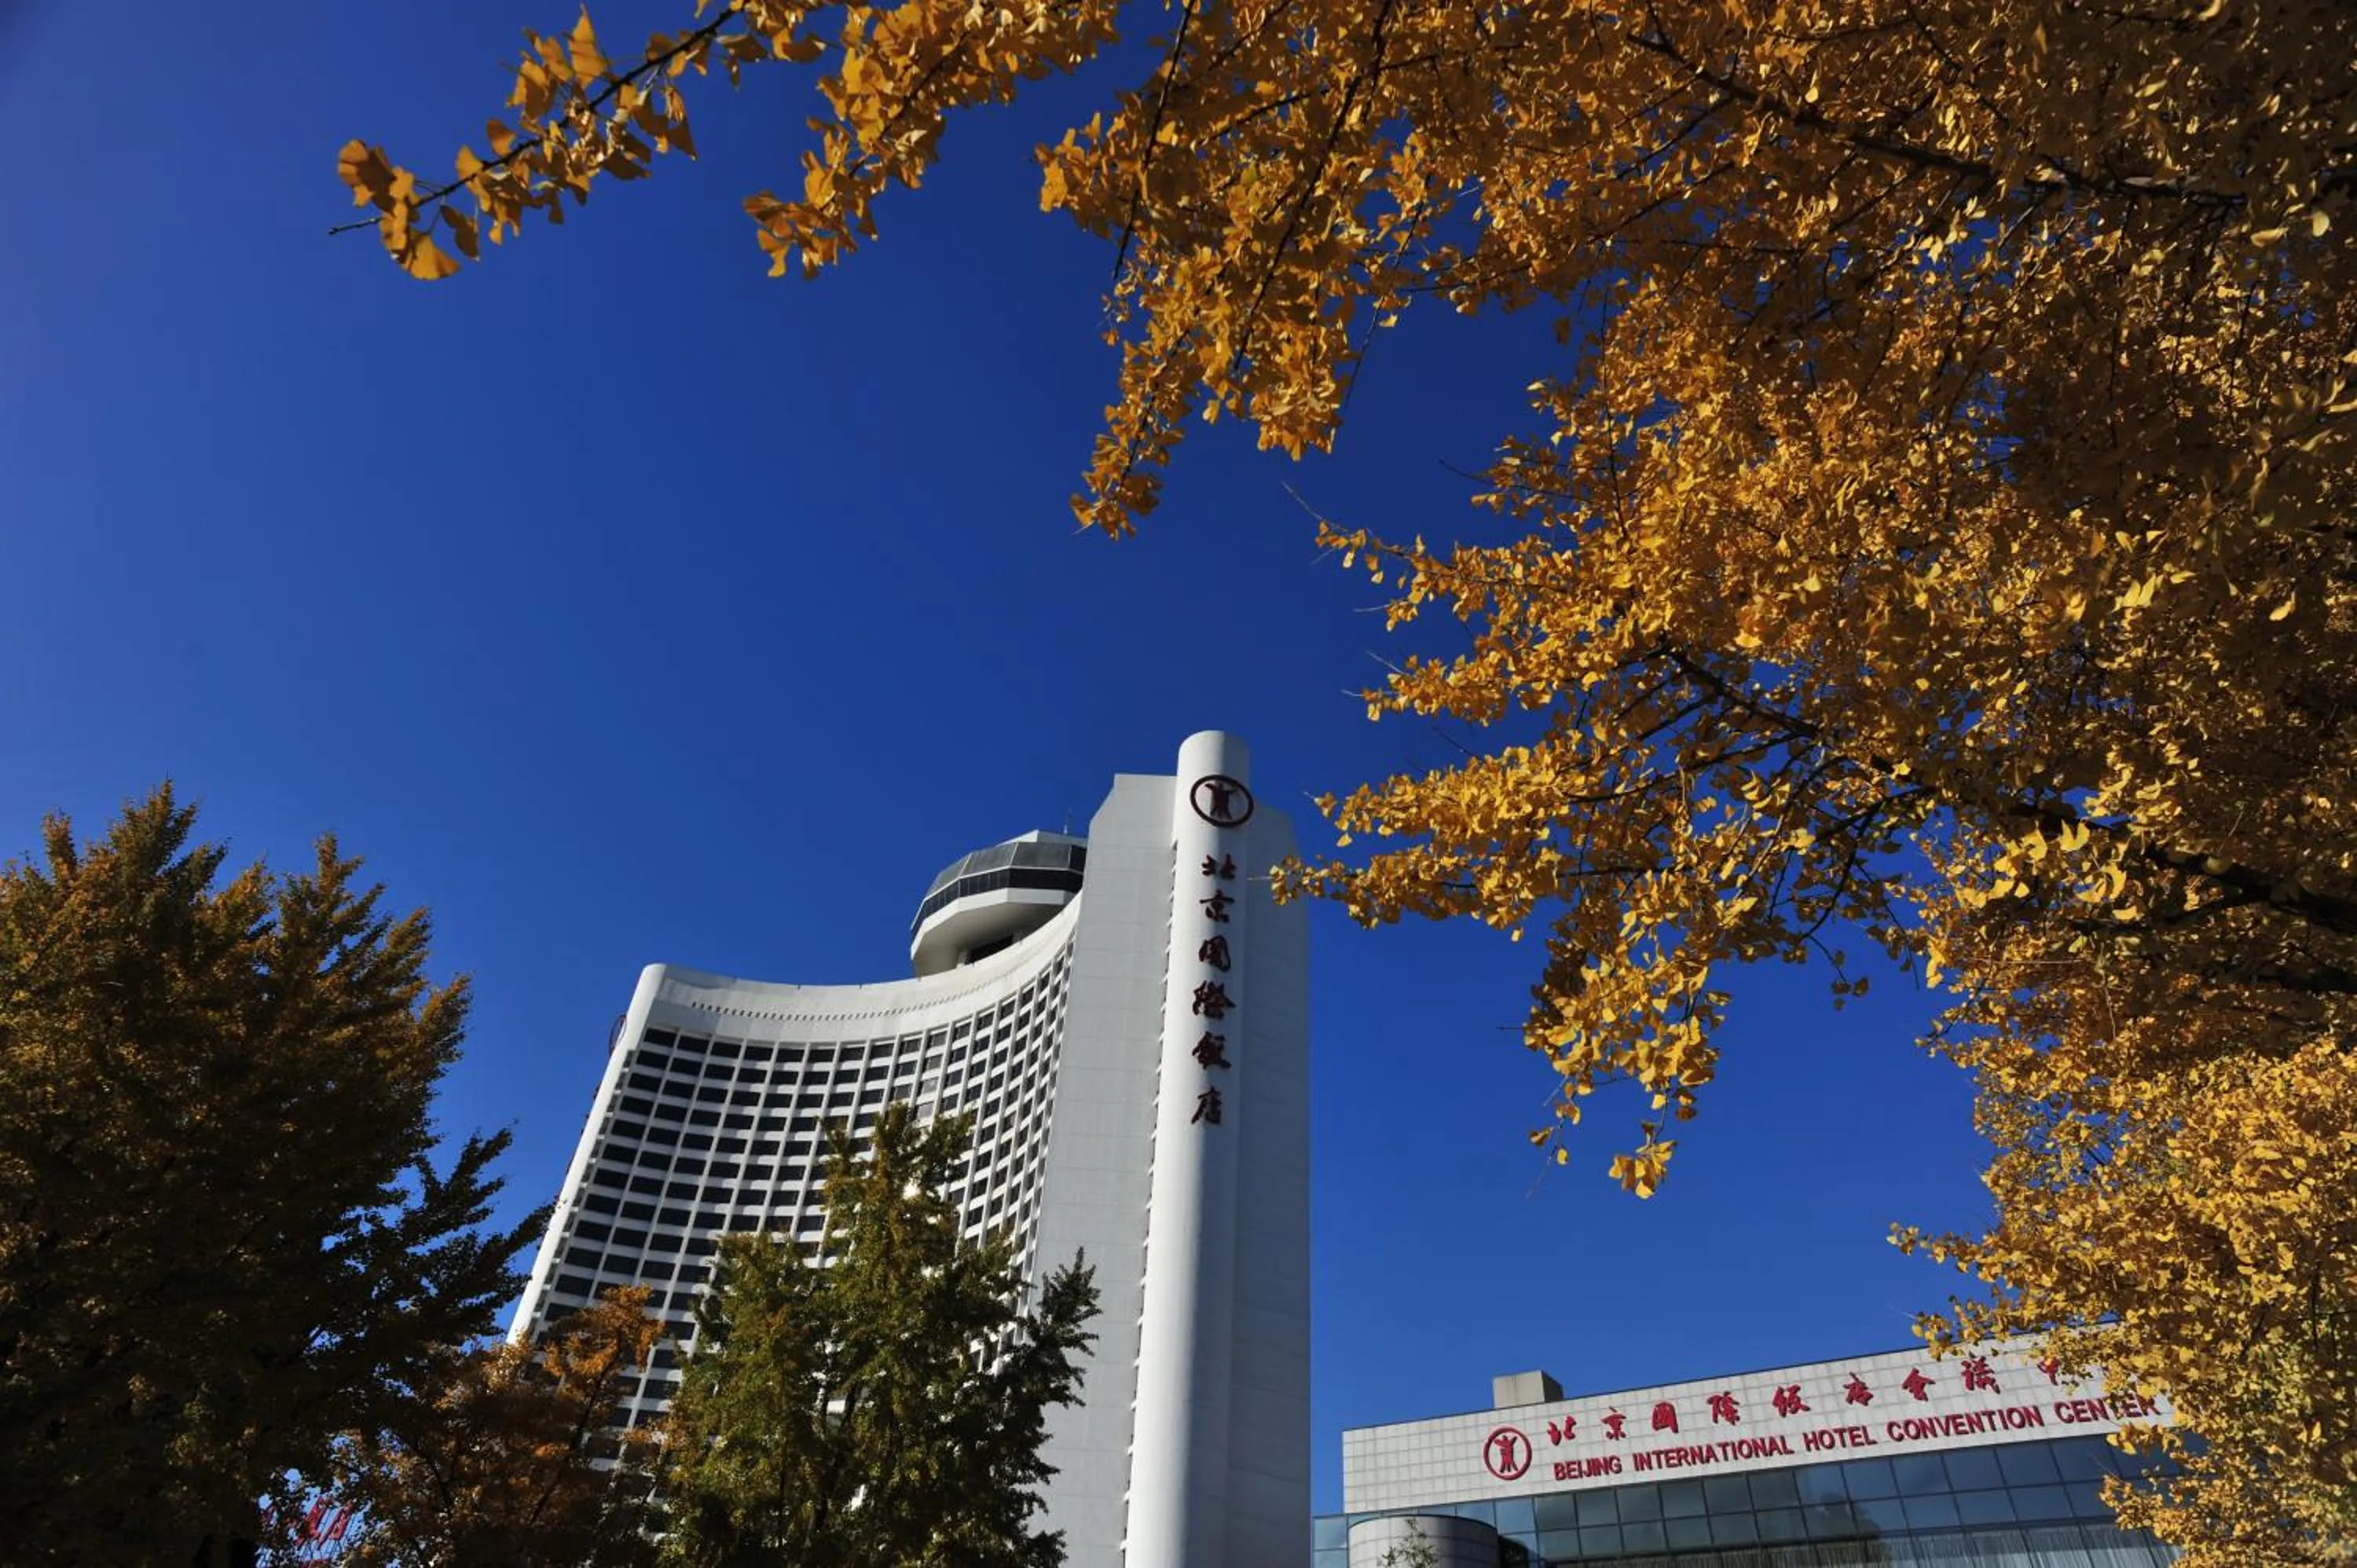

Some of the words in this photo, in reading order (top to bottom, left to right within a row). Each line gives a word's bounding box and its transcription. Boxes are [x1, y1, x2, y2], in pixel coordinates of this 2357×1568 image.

[1553, 1455, 1623, 1481] BEIJING
[1633, 1434, 1795, 1472] INTERNATIONAL
[1803, 1424, 1878, 1452] HOTEL
[1886, 1405, 2045, 1442] CONVENTION
[2054, 1394, 2161, 1424] CENER
